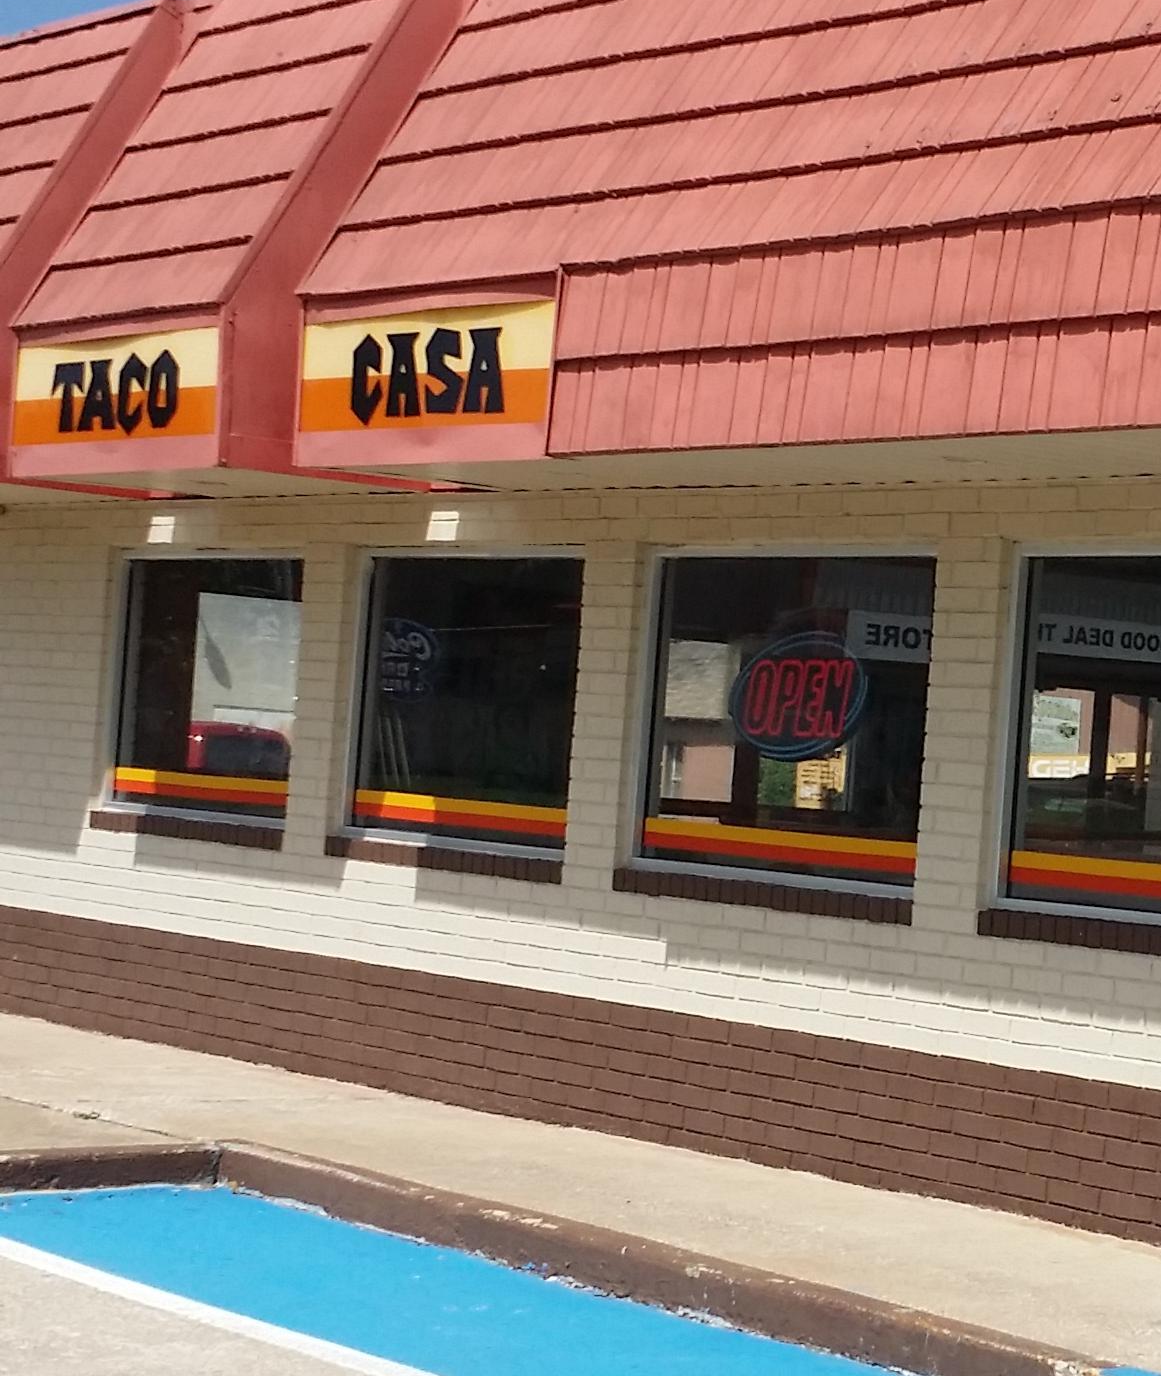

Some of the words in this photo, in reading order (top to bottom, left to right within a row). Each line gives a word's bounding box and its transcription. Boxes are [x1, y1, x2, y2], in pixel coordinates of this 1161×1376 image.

[52, 349, 180, 435] TACO
[351, 326, 505, 427] CASA
[744, 659, 856, 738] OPEN
